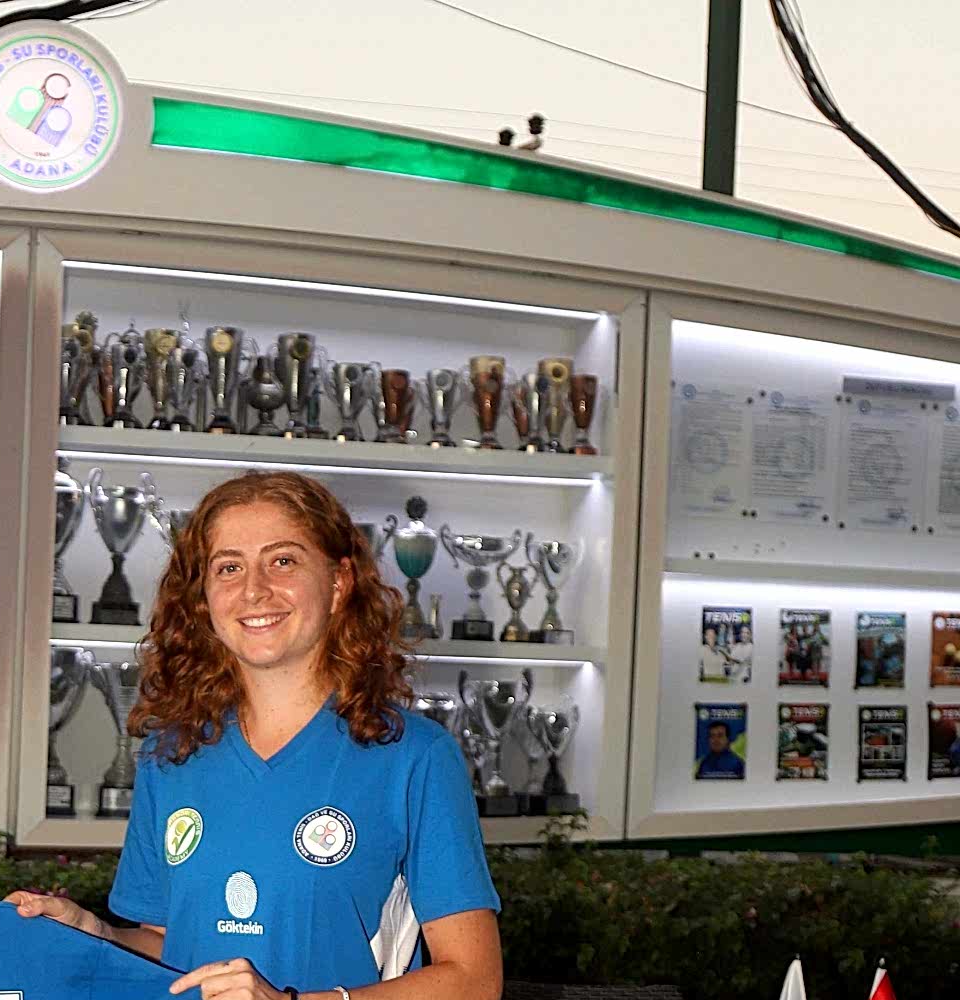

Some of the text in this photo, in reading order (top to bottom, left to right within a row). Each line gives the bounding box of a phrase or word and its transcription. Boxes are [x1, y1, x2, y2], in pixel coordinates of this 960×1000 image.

[11, 45, 33, 60] SU
[35, 44, 103, 94] SPORLARI
[9, 158, 73, 177] ADANA
[216, 919, 265, 936] Göktekin
